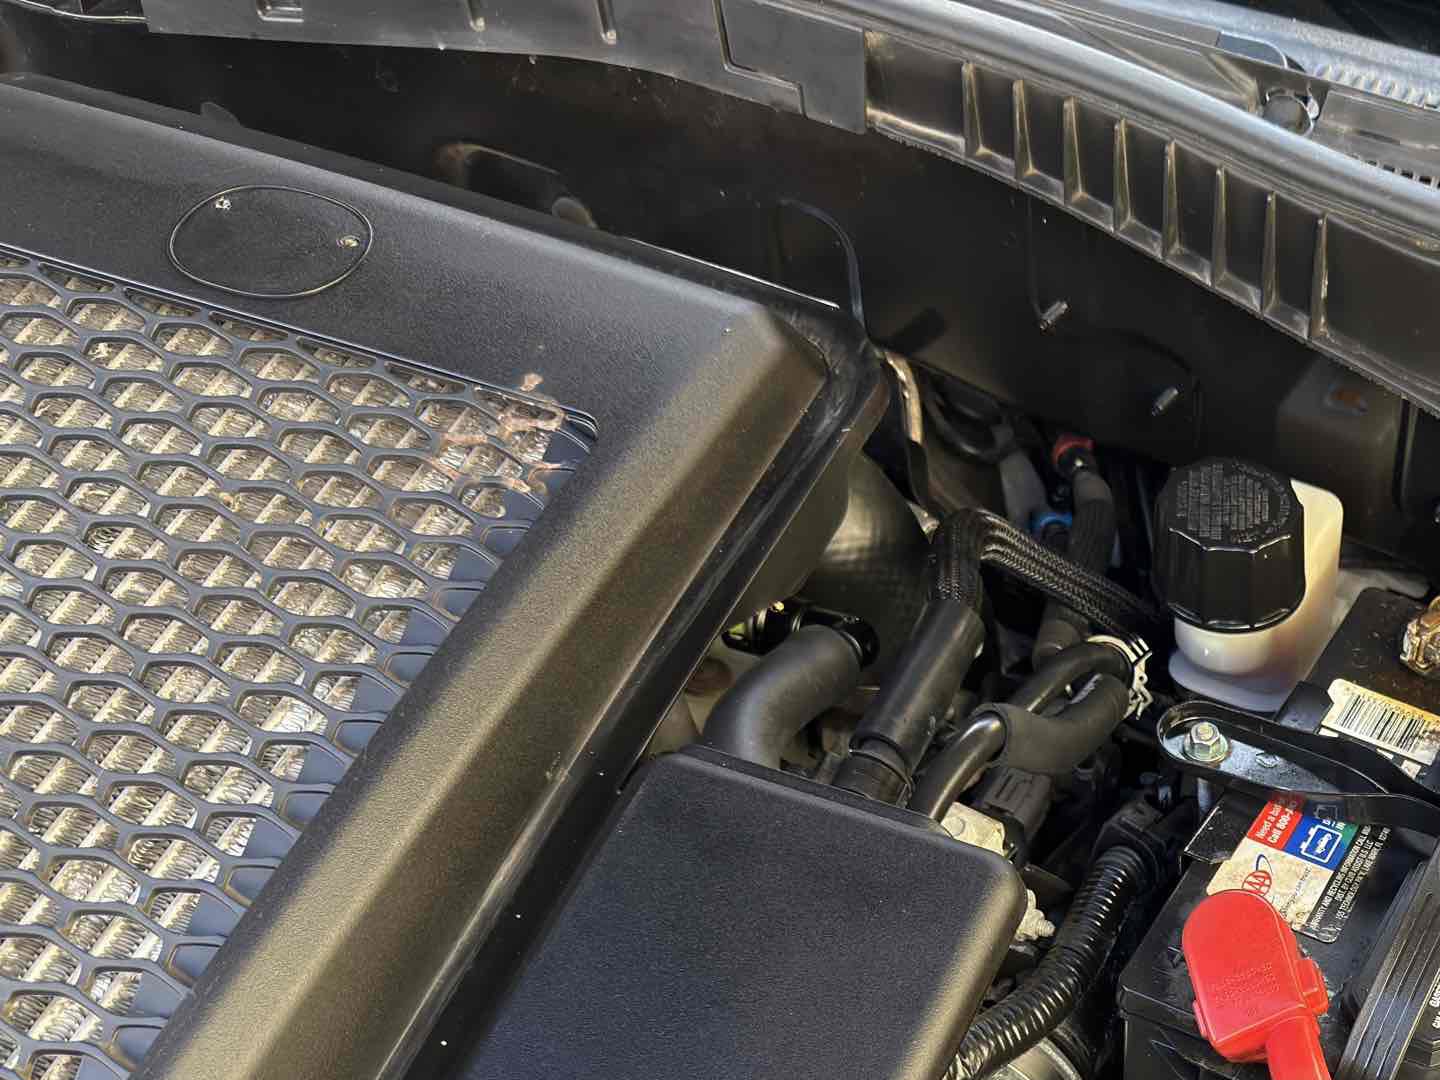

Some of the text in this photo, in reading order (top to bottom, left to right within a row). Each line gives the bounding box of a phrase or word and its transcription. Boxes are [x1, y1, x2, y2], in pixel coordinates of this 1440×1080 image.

[1256, 821, 1271, 838] Need
[1269, 829, 1281, 843] Call
[1326, 871, 1345, 897] RECYCLING
